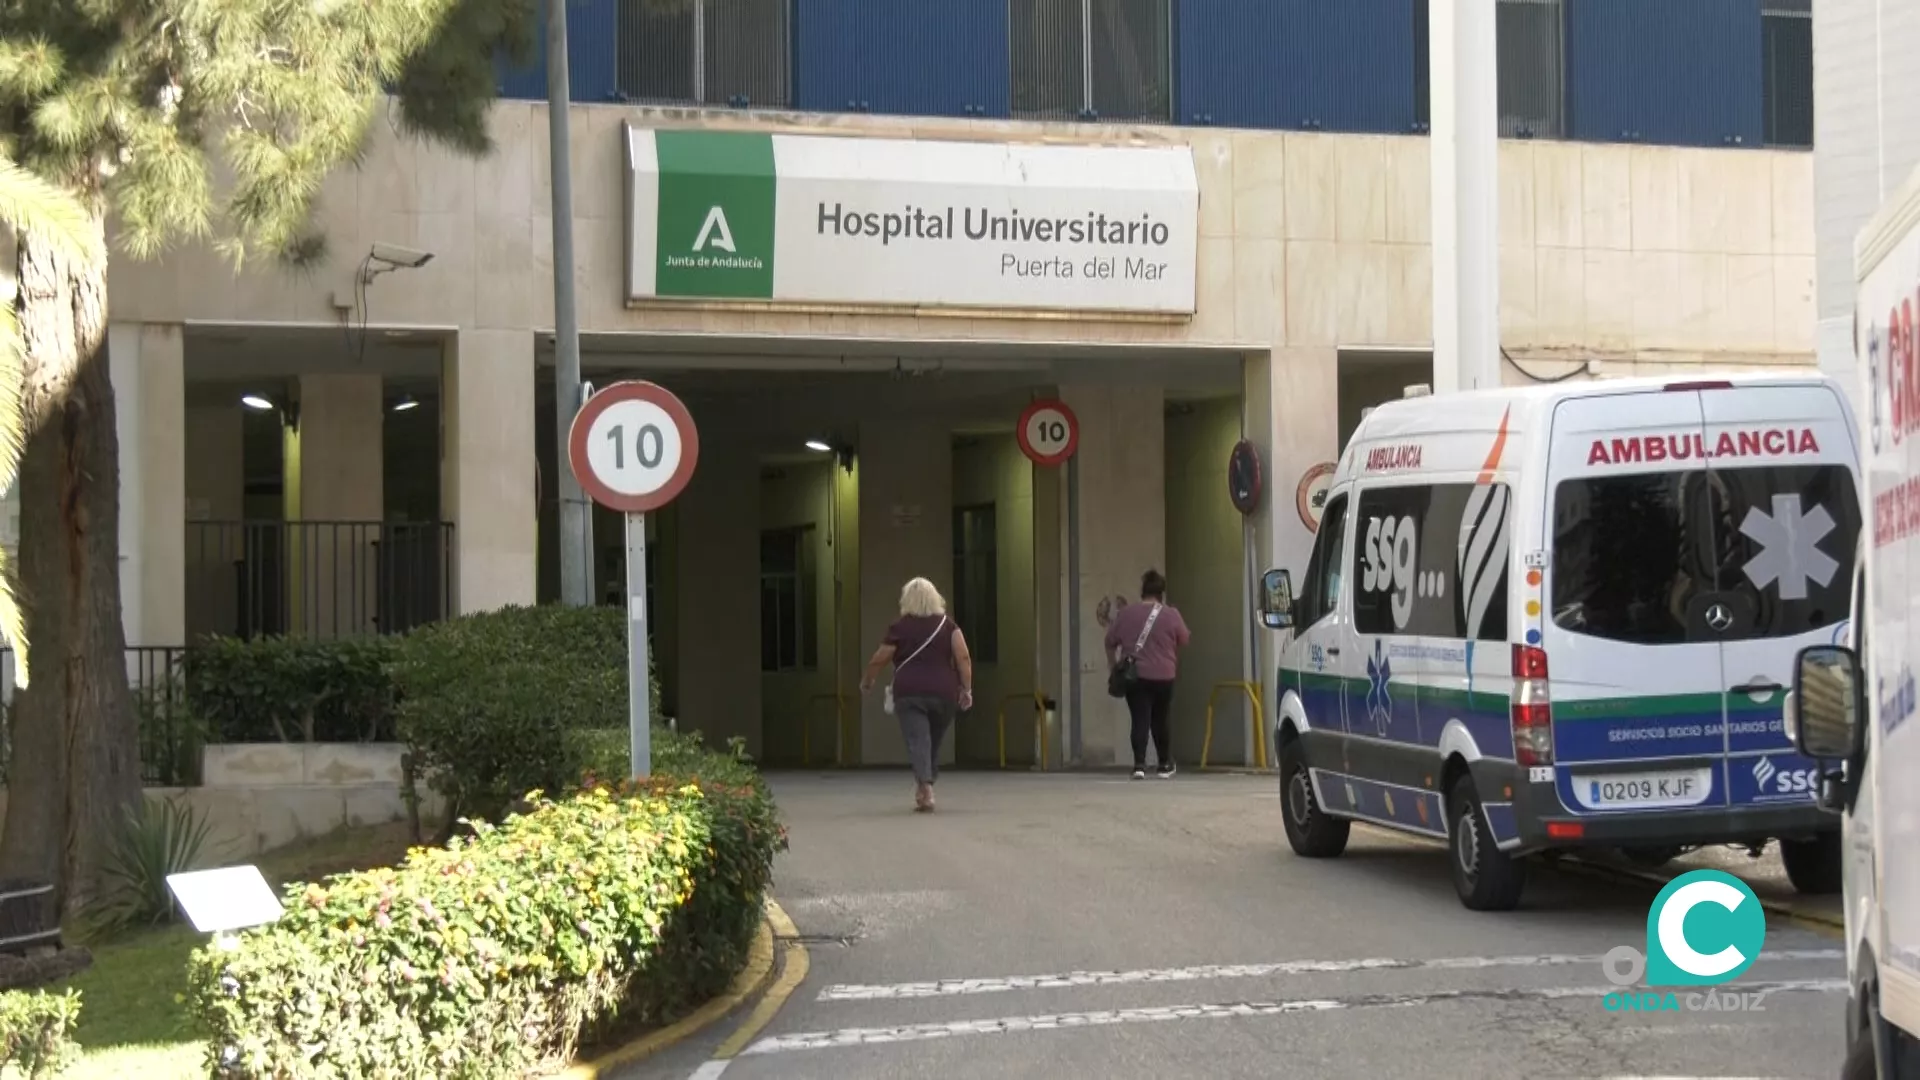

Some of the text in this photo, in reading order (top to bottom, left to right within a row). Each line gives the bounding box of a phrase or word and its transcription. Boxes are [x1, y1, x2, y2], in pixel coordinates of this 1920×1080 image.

[817, 202, 1170, 246] Hospital Universitario
[665, 255, 763, 269] Junta de Andalucía
[1001, 253, 1168, 281] Puerta del Mar
[1038, 421, 1065, 442] 10
[607, 423, 664, 470] 10
[1366, 445, 1422, 471] AMBULANCIA
[1587, 428, 1820, 466] AMBULANCIA
[1704, 721, 1766, 736] SANTARIOS
[1603, 778, 1694, 800] 0209 KJF
